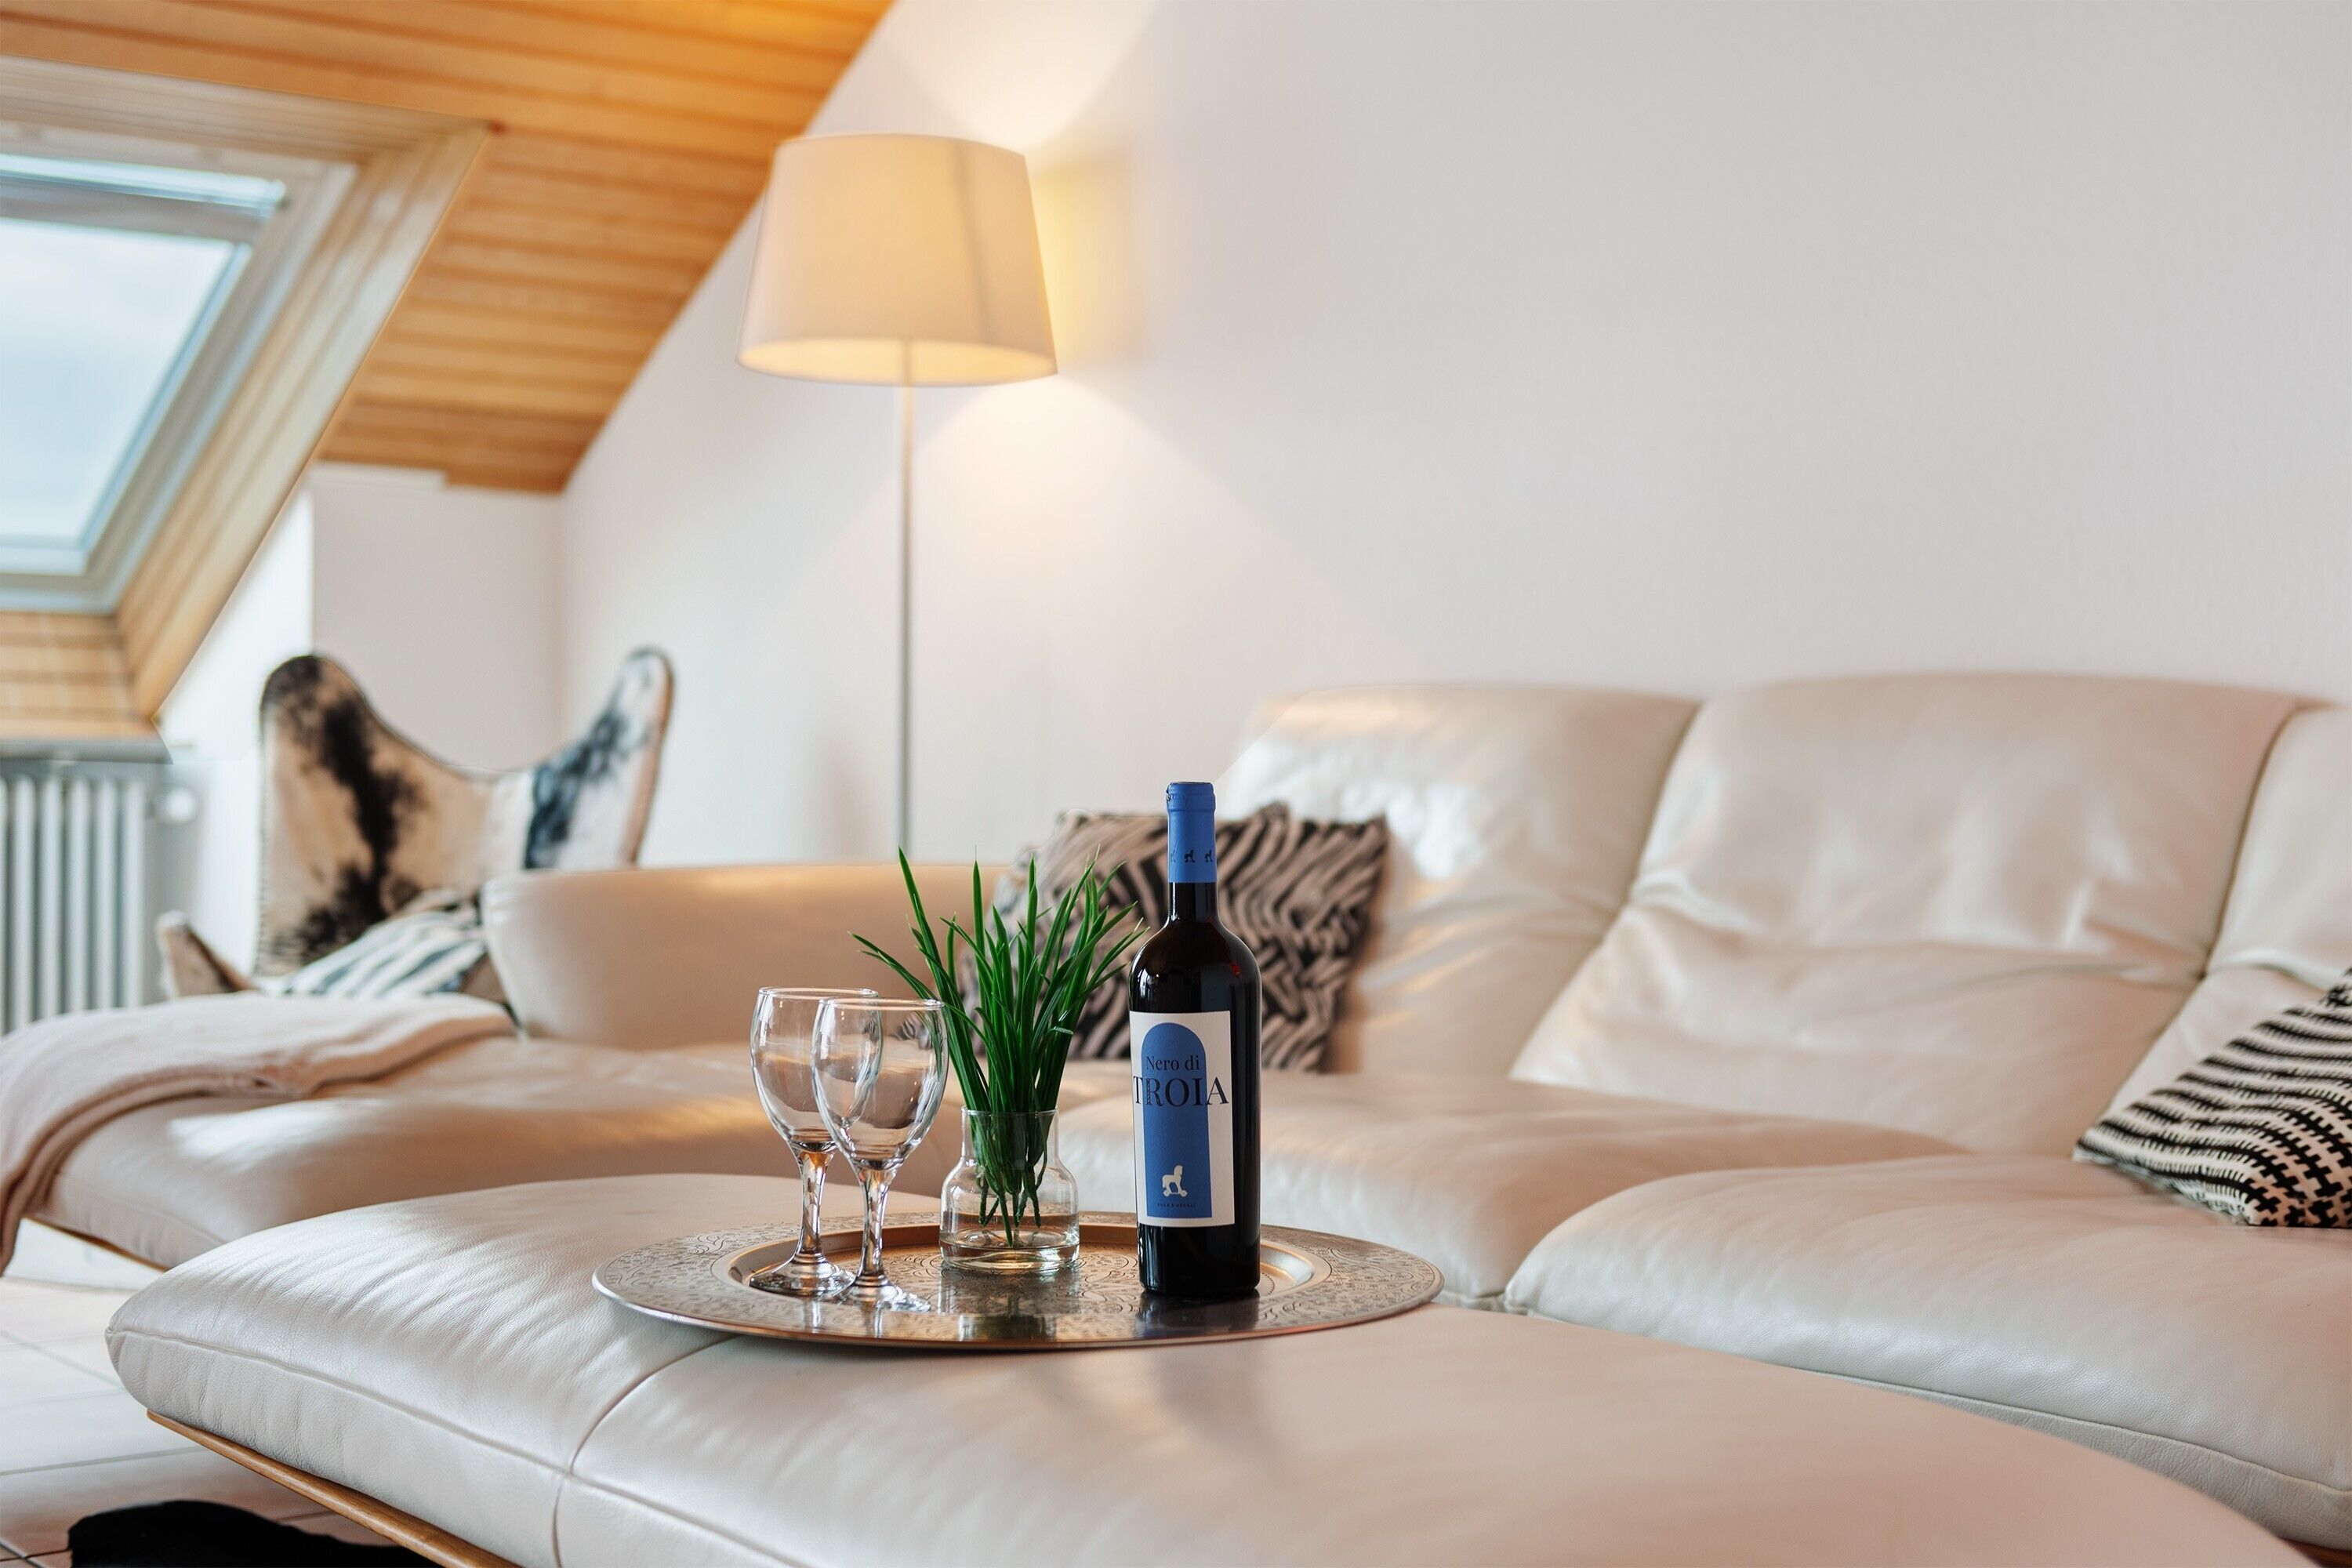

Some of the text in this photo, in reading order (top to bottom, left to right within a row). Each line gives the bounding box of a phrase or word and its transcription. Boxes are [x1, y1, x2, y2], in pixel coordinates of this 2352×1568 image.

[1146, 1054, 1200, 1071] Nero di
[1133, 1076, 1229, 1107] TROIA
